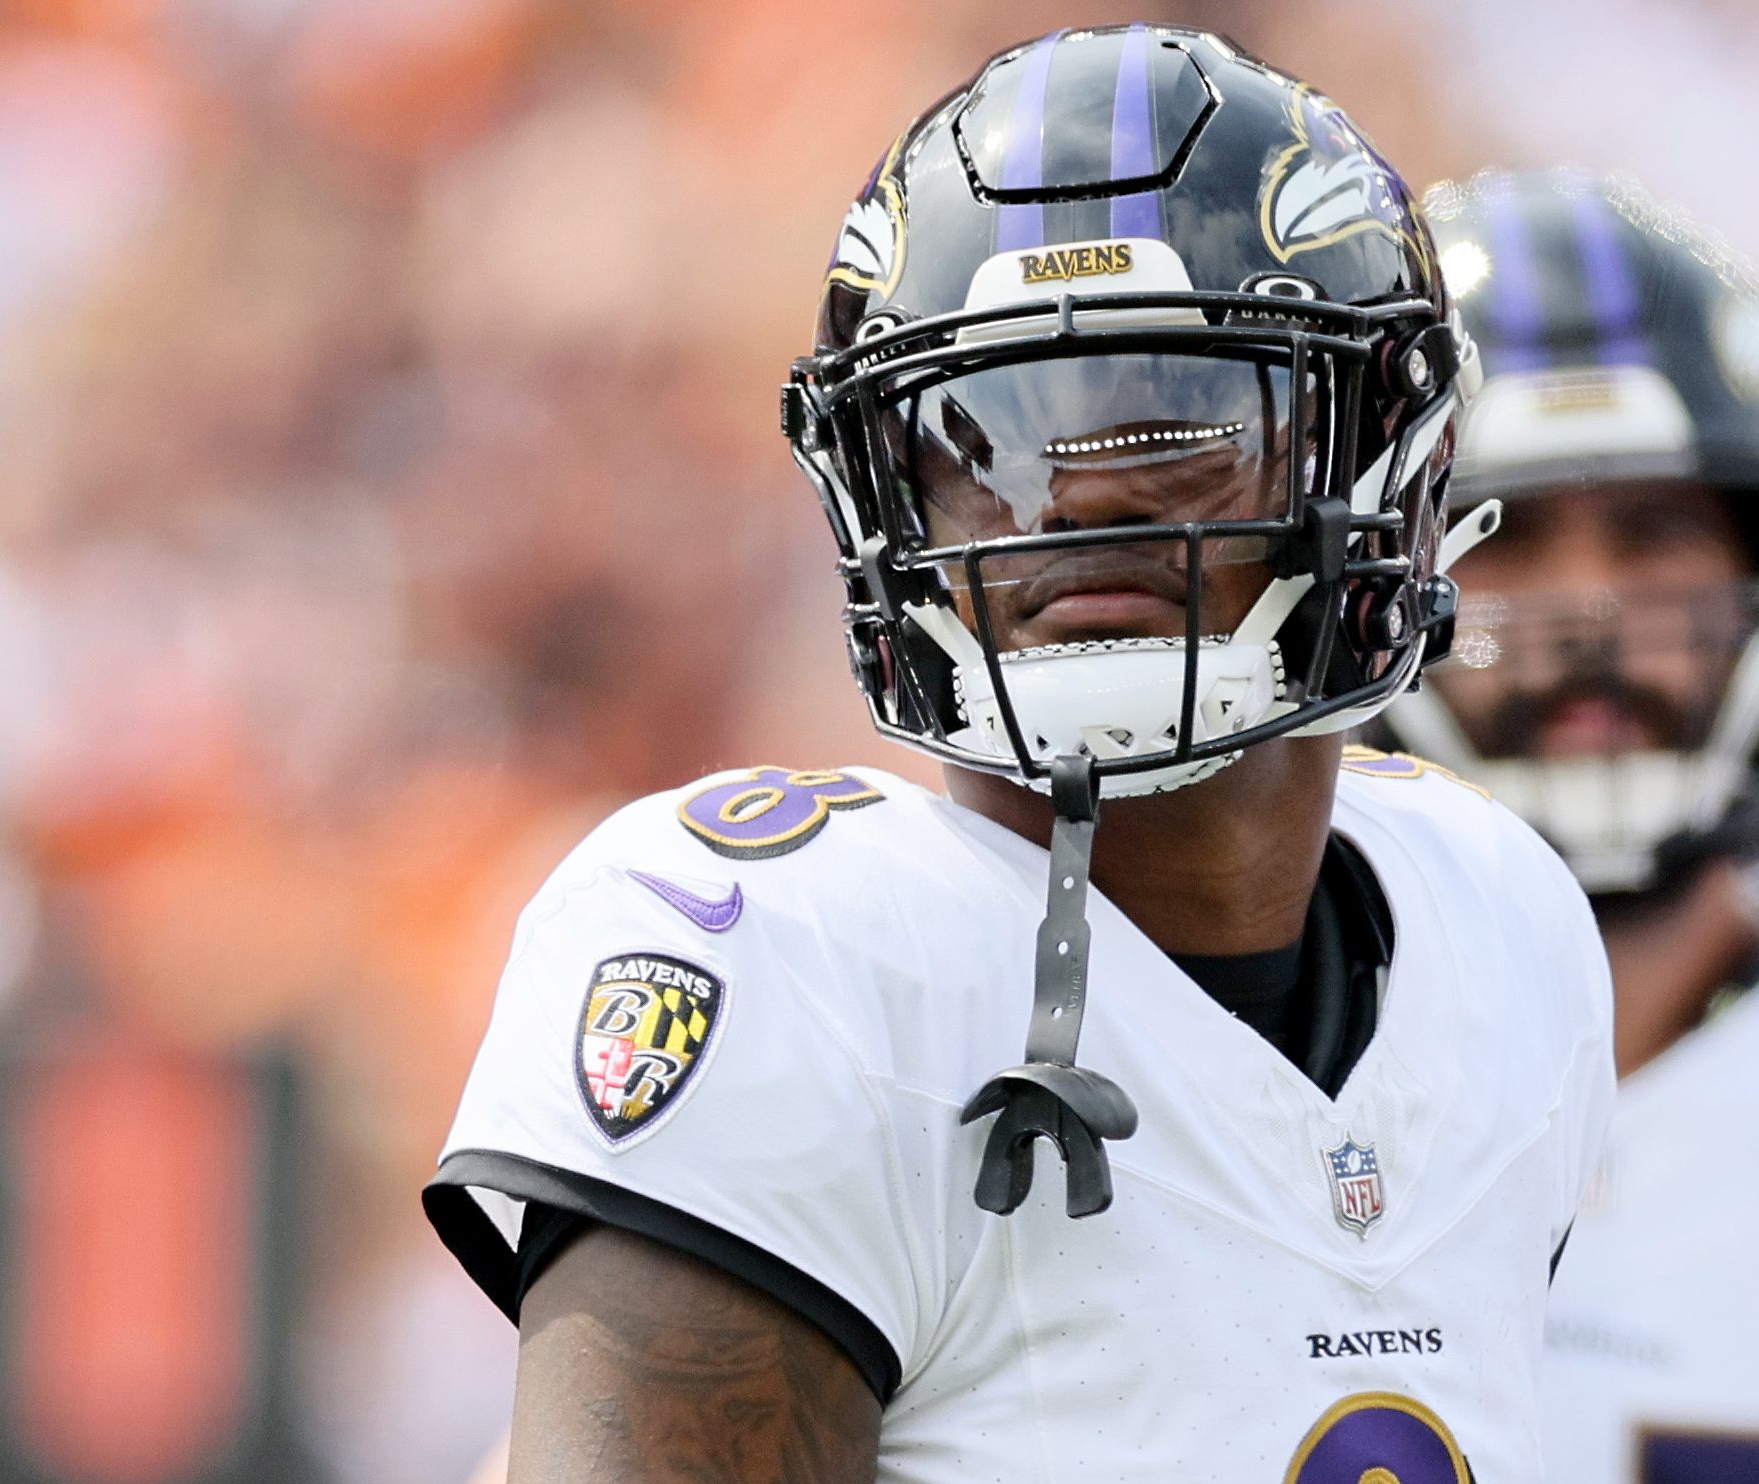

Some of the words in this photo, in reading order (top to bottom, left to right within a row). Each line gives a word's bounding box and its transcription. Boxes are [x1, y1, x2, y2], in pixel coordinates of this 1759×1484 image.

[1019, 244, 1133, 283] RAVENS
[601, 959, 712, 999] RAVENS
[591, 985, 652, 1036] B
[623, 1048, 683, 1106] R
[1342, 1178, 1382, 1219] NFL
[1306, 1328, 1443, 1359] RAVENS
